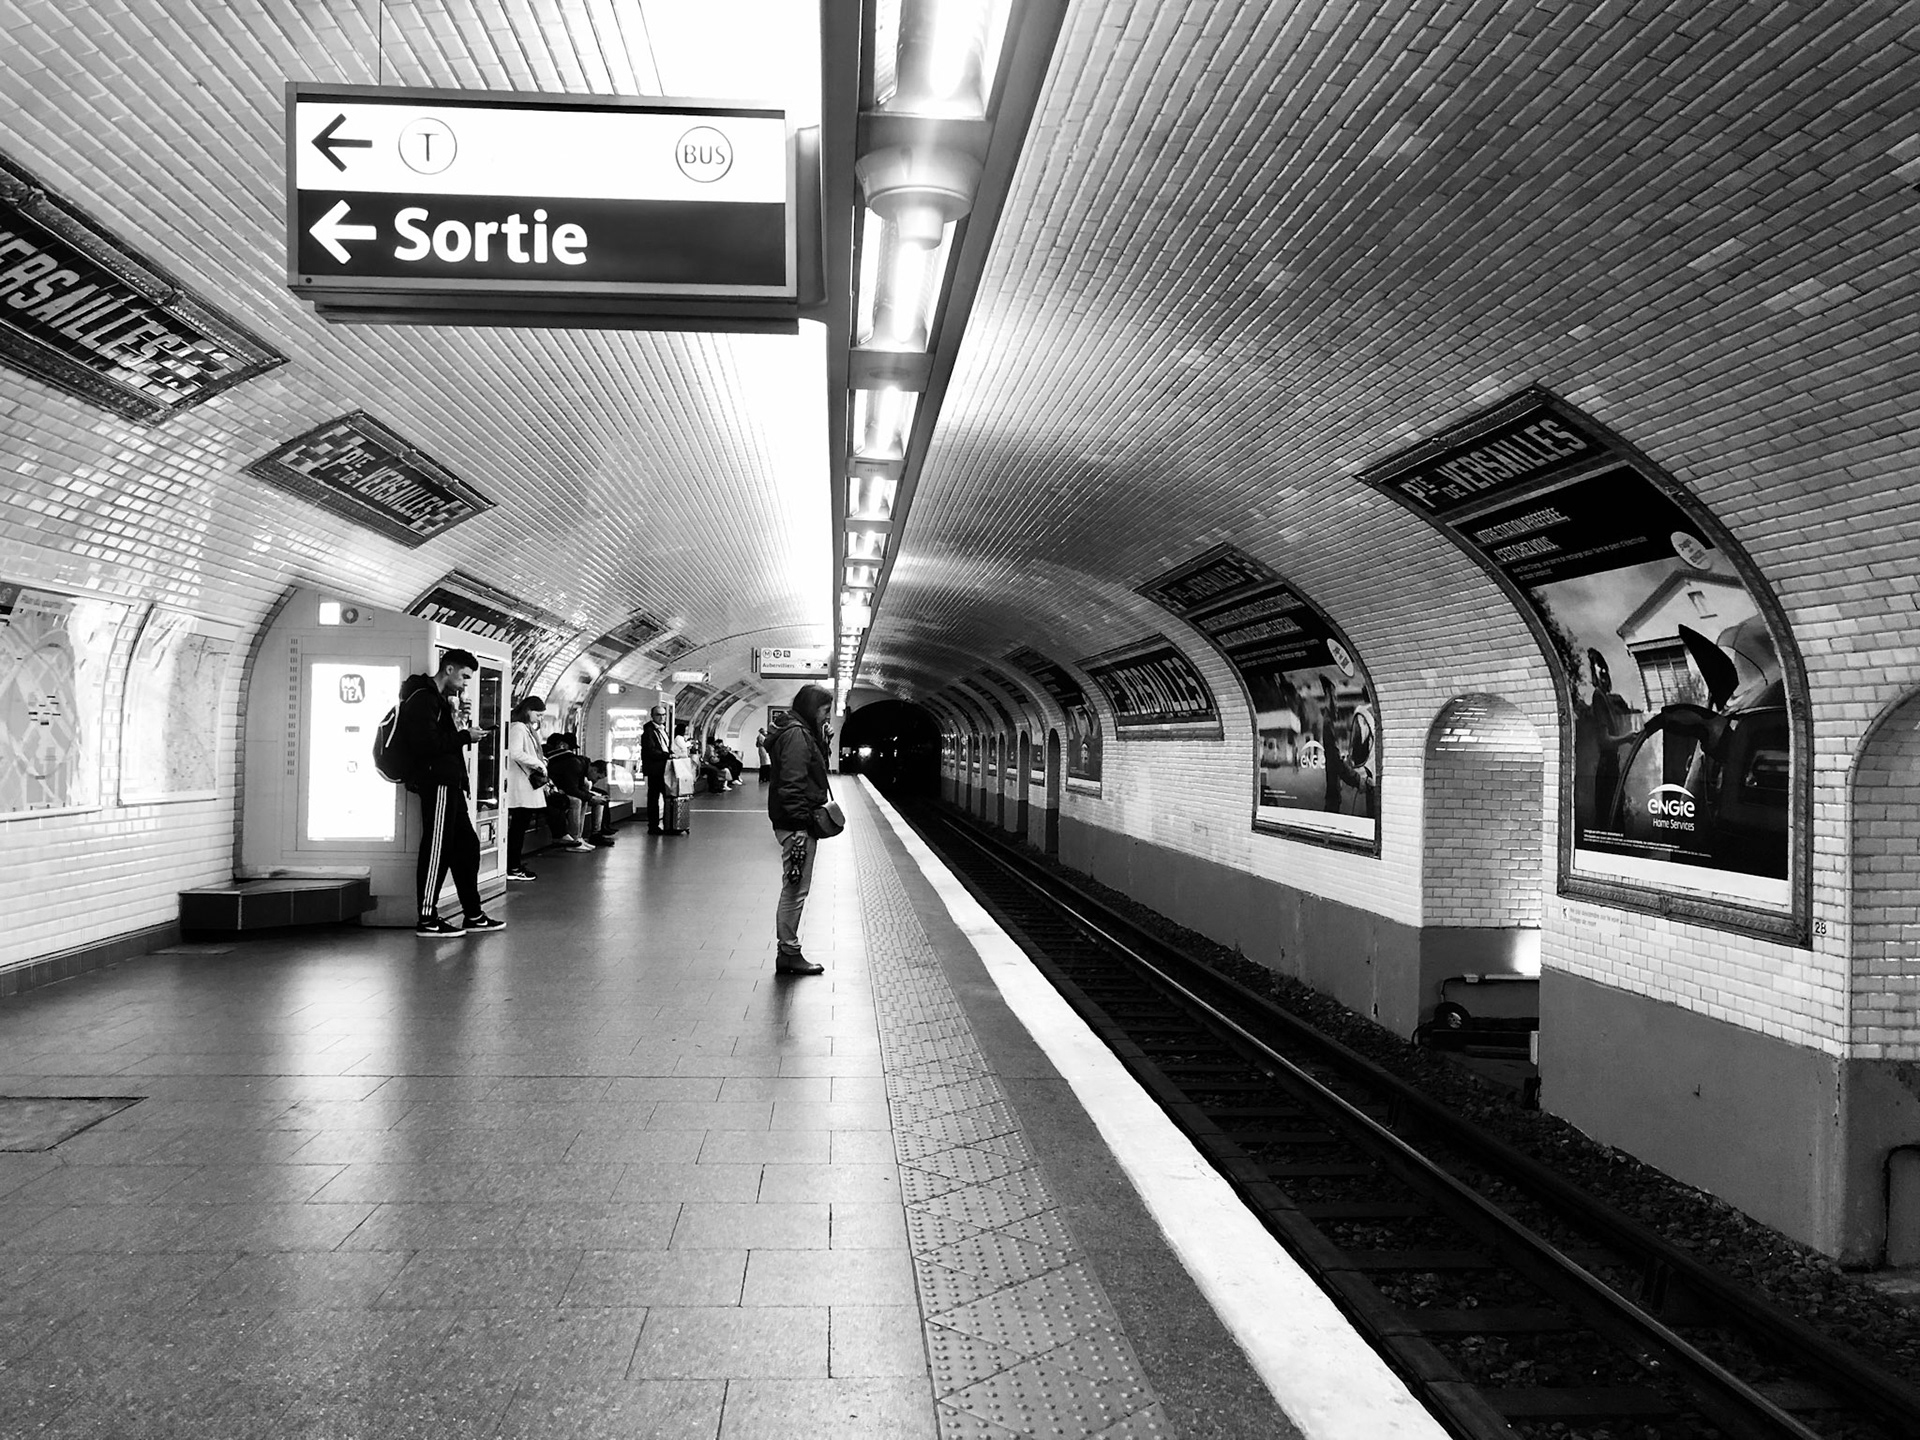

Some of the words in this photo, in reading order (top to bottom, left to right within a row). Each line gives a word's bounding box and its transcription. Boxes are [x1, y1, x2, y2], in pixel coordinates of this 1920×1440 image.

[416, 133, 440, 162] T
[683, 144, 725, 166] BUS
[393, 206, 589, 265] Sortie
[1435, 419, 1588, 492] VERSAILLES
[352, 465, 446, 520] VERSAILLES
[1441, 483, 1468, 499] DE
[1110, 657, 1207, 714] VERSAILLES
[1653, 818, 1670, 829] Home
[1670, 819, 1695, 831] Services
[1815, 921, 1827, 935] 28
